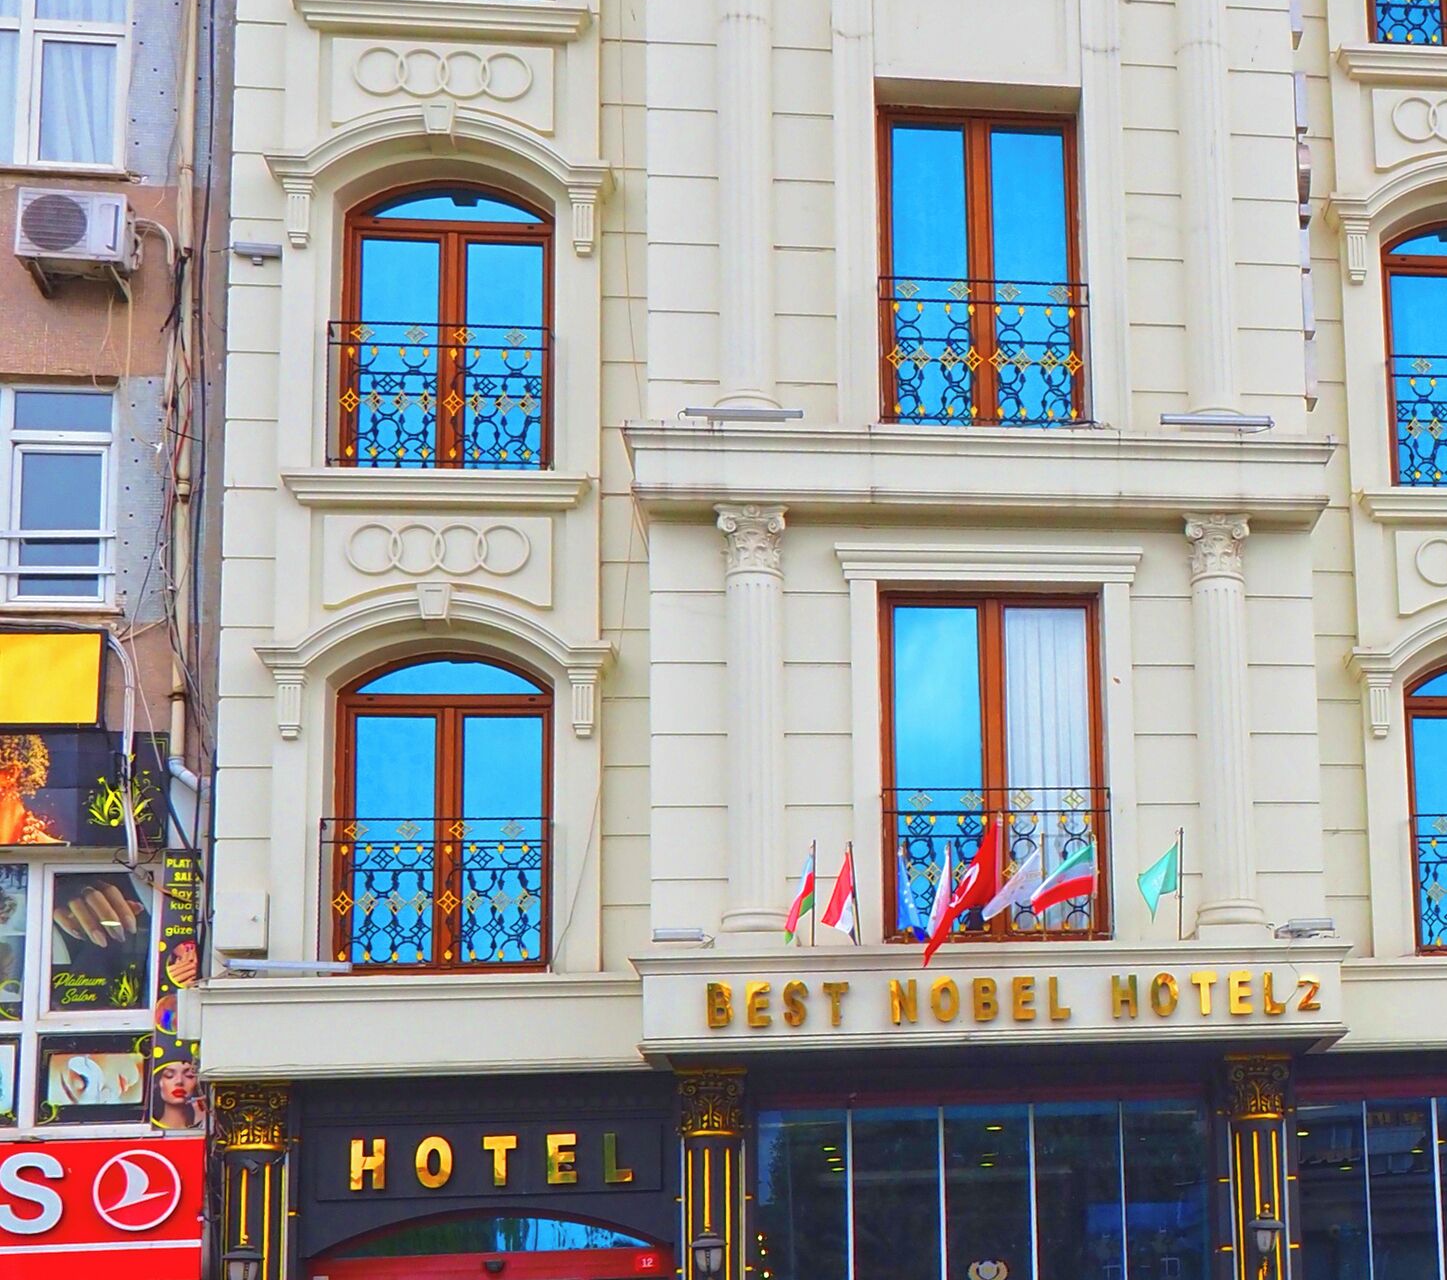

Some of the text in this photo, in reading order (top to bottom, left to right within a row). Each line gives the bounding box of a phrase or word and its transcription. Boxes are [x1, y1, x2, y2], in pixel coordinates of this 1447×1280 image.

[165, 924, 196, 937] güze
[52, 972, 106, 989] Platinum
[61, 988, 97, 1005] Salon
[707, 970, 1321, 1028] BEST NOBEL HOTEL 2
[350, 1132, 634, 1191] HOTEL
[641, 1257, 654, 1268] 12
